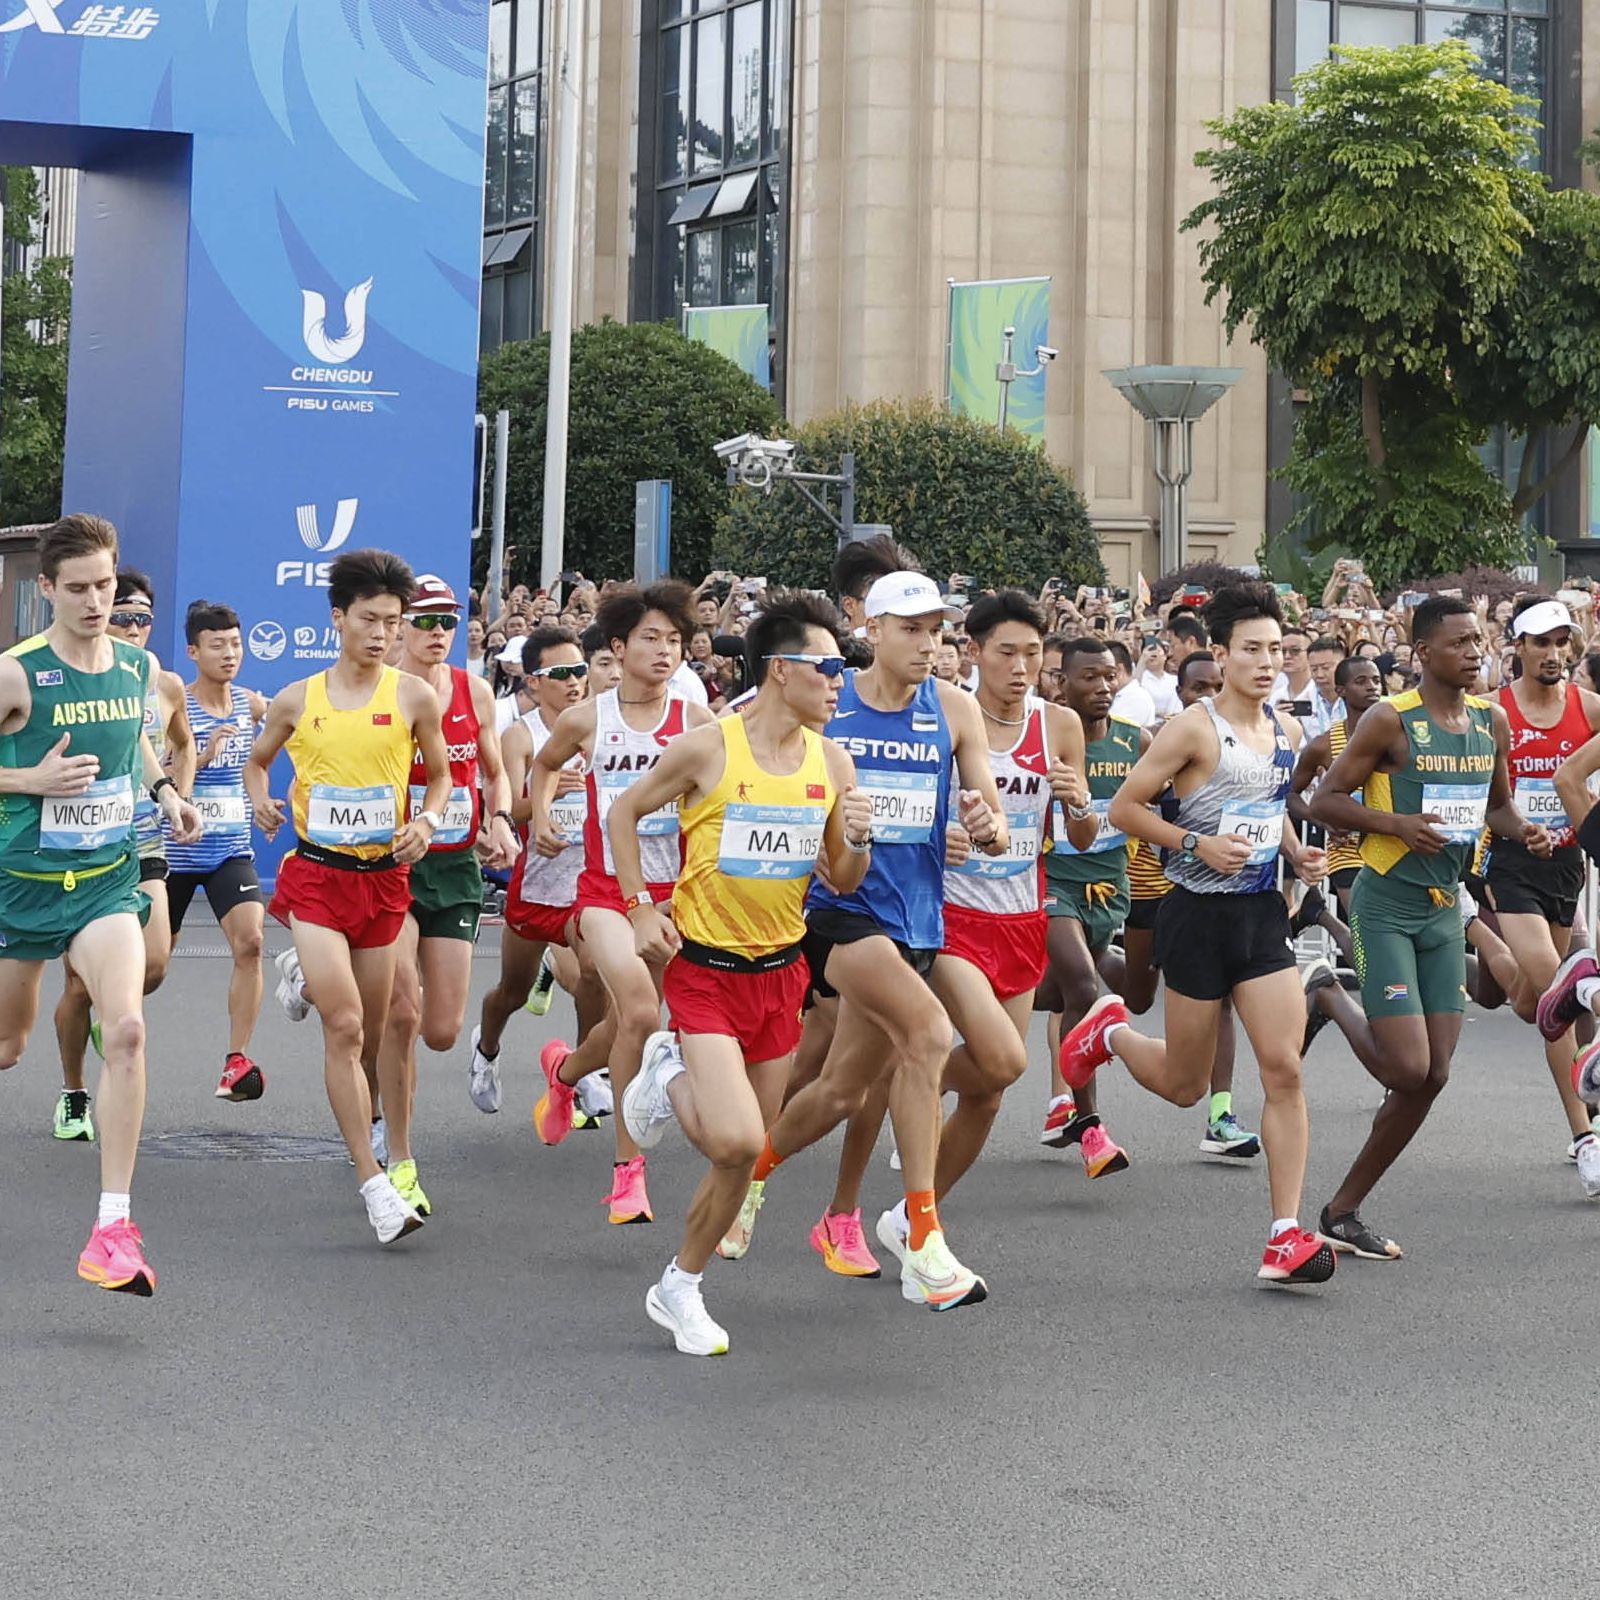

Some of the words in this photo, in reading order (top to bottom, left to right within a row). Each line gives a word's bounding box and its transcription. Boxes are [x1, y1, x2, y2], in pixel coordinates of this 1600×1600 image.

[291, 367, 373, 383] CHENGDU
[287, 397, 327, 410] FISU
[332, 400, 374, 412] GAMES
[52, 697, 142, 727] AUSTRALIA
[833, 736, 940, 763] ESTONIA
[1089, 761, 1132, 778] AFRICA
[1416, 754, 1457, 773] SOUTH
[1233, 766, 1290, 786] KOREA
[53, 801, 115, 826] VINCENT
[114, 805, 131, 821] 102
[329, 807, 367, 826] MA
[375, 811, 393, 827] 104
[452, 813, 470, 825] 126
[911, 805, 933, 823] 115
[747, 830, 790, 853] MA
[799, 838, 818, 856] 105
[1015, 840, 1034, 857] 132
